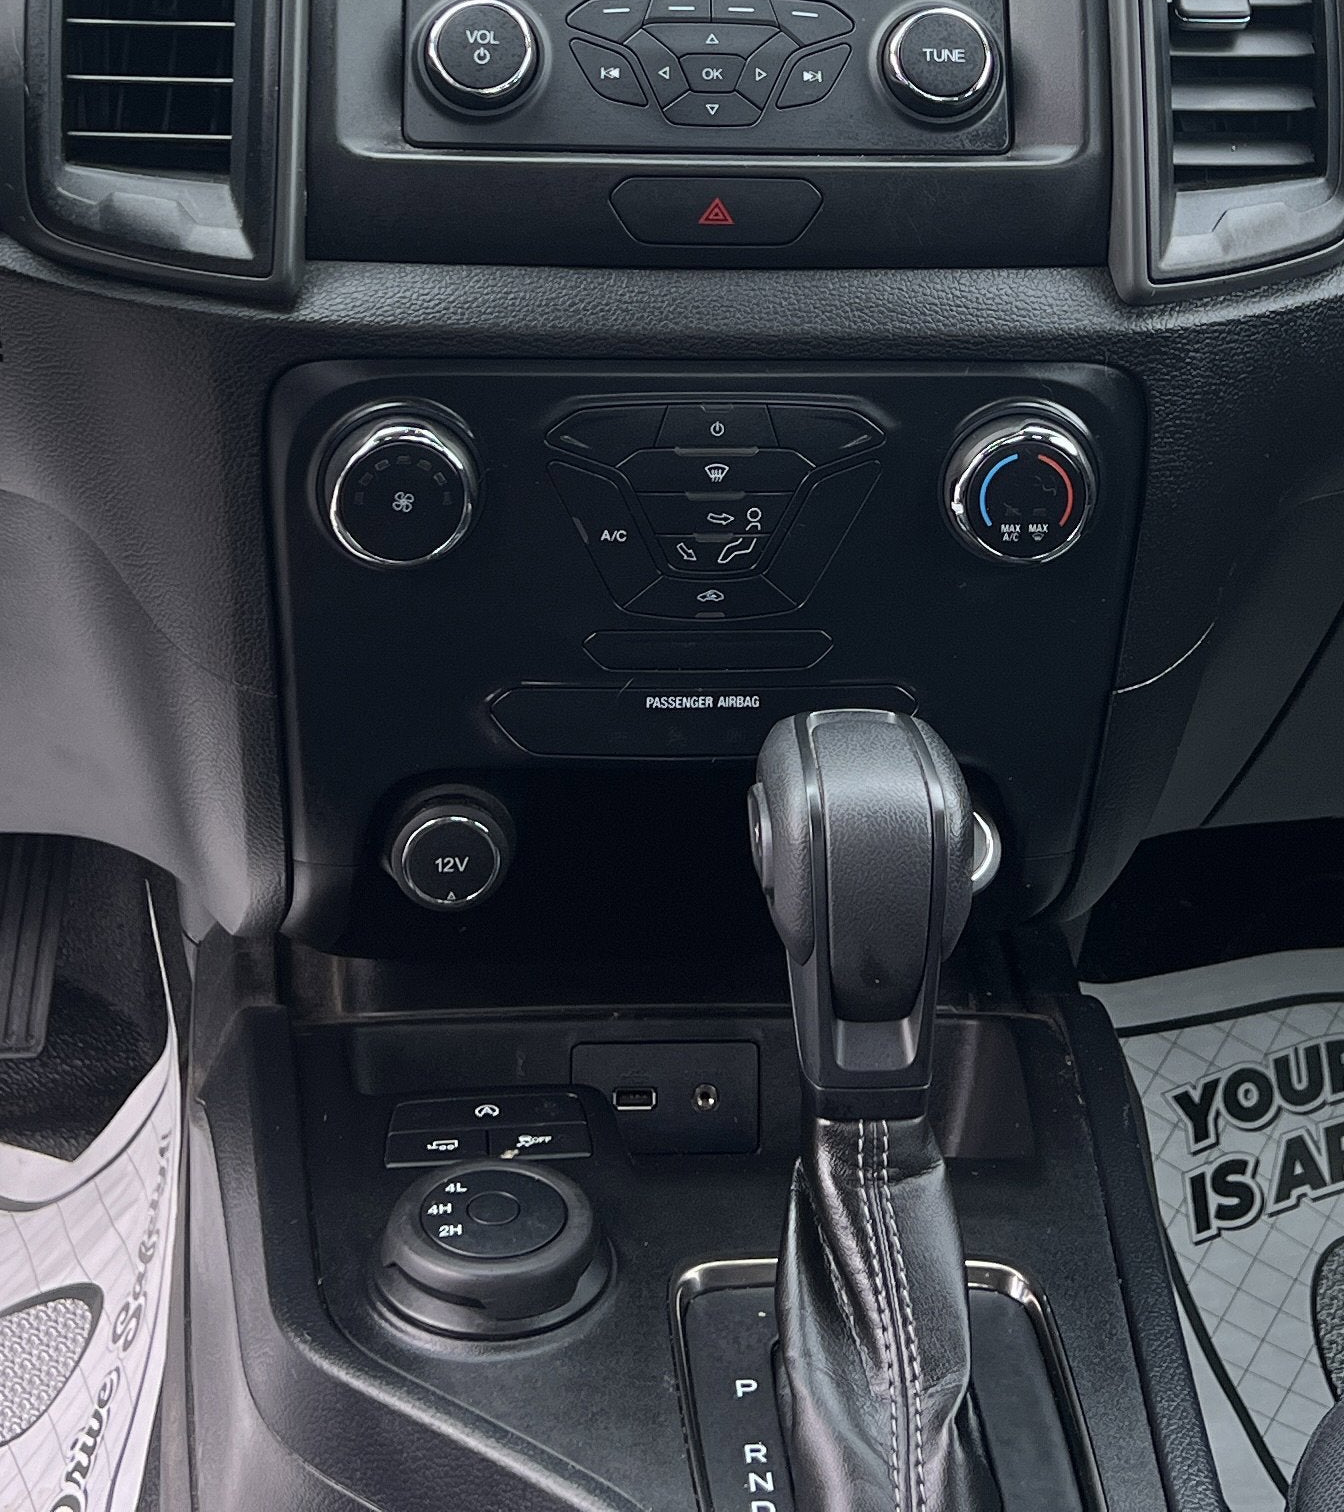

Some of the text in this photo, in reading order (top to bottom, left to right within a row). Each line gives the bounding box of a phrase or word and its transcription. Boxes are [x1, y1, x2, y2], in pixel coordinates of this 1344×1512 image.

[465, 29, 501, 45] VOL
[922, 48, 966, 63] TUNE
[701, 67, 723, 80] OK
[1000, 523, 1021, 533] MAX
[1028, 523, 1049, 533] MAX
[600, 529, 627, 542] A/C
[1002, 533, 1020, 542] A/C
[645, 695, 760, 708] PASSENGER AIRBAG
[434, 856, 469, 873] 12V
[444, 1182, 468, 1194] 4L
[1187, 1155, 1259, 1238] IS
[426, 1202, 453, 1216] 4H
[438, 1223, 463, 1238] 2H
[735, 1379, 758, 1398] P
[744, 1442, 768, 1464] R
[748, 1471, 775, 1493] N
